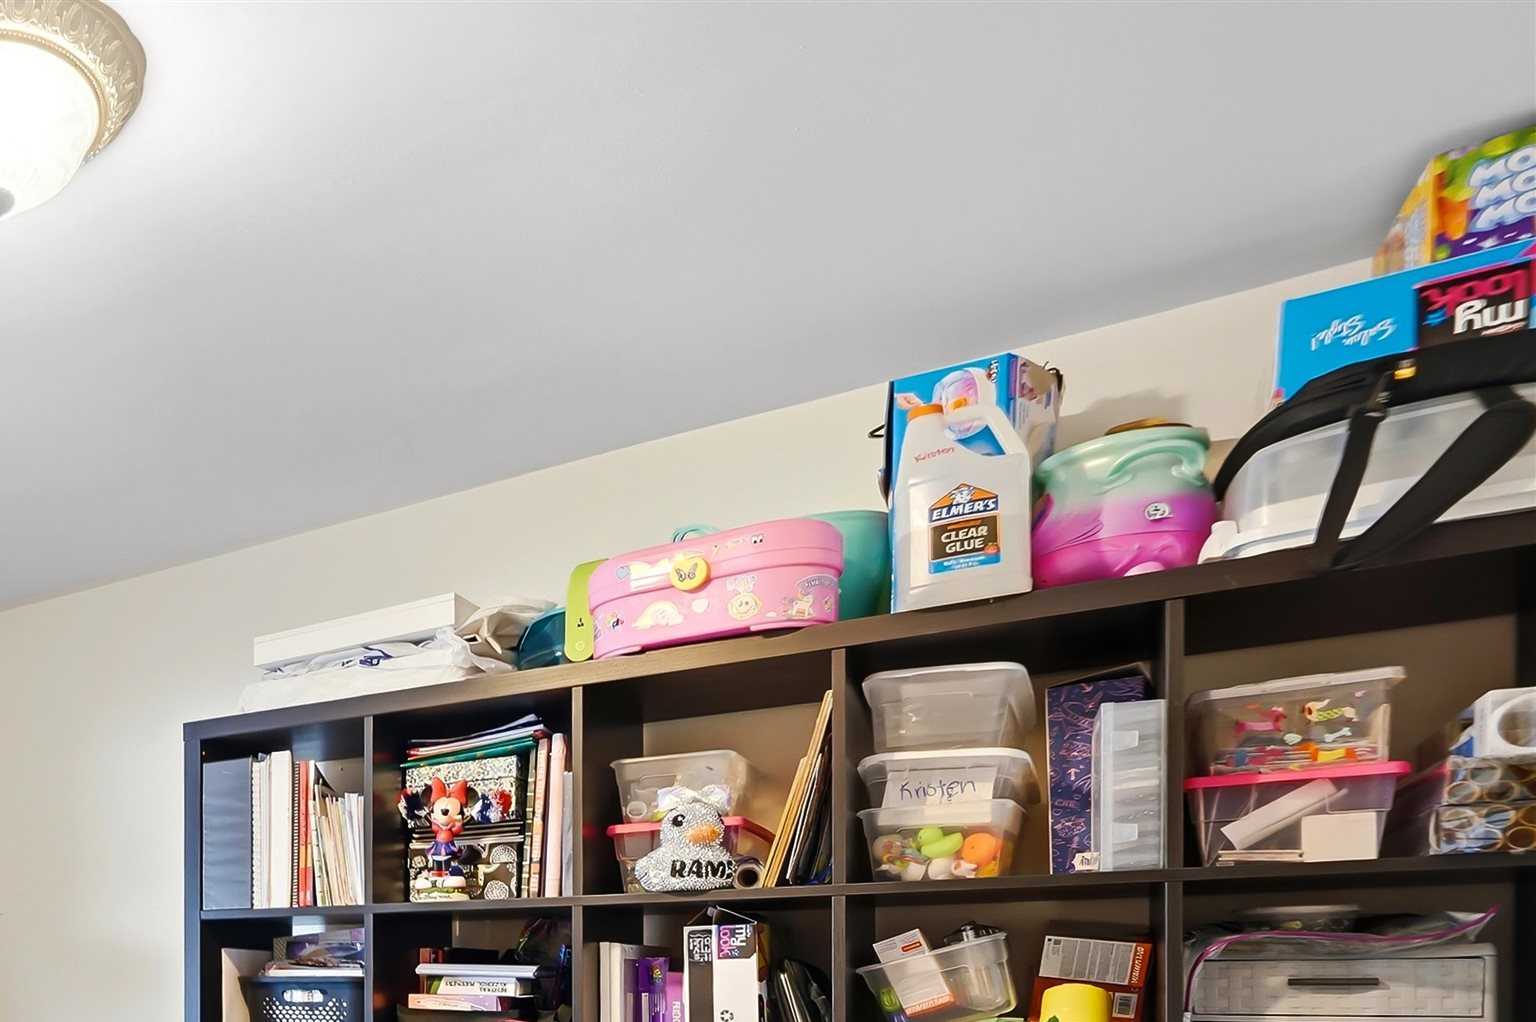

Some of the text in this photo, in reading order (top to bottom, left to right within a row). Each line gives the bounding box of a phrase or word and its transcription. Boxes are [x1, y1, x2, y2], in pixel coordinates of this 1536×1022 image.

[1420, 266, 1529, 313] look
[1453, 298, 1528, 334] my
[931, 498, 997, 522] ELMER'S
[941, 524, 989, 544] CLEAR
[945, 538, 985, 555] GLUE
[899, 778, 977, 801] Kristen
[719, 925, 732, 958] look
